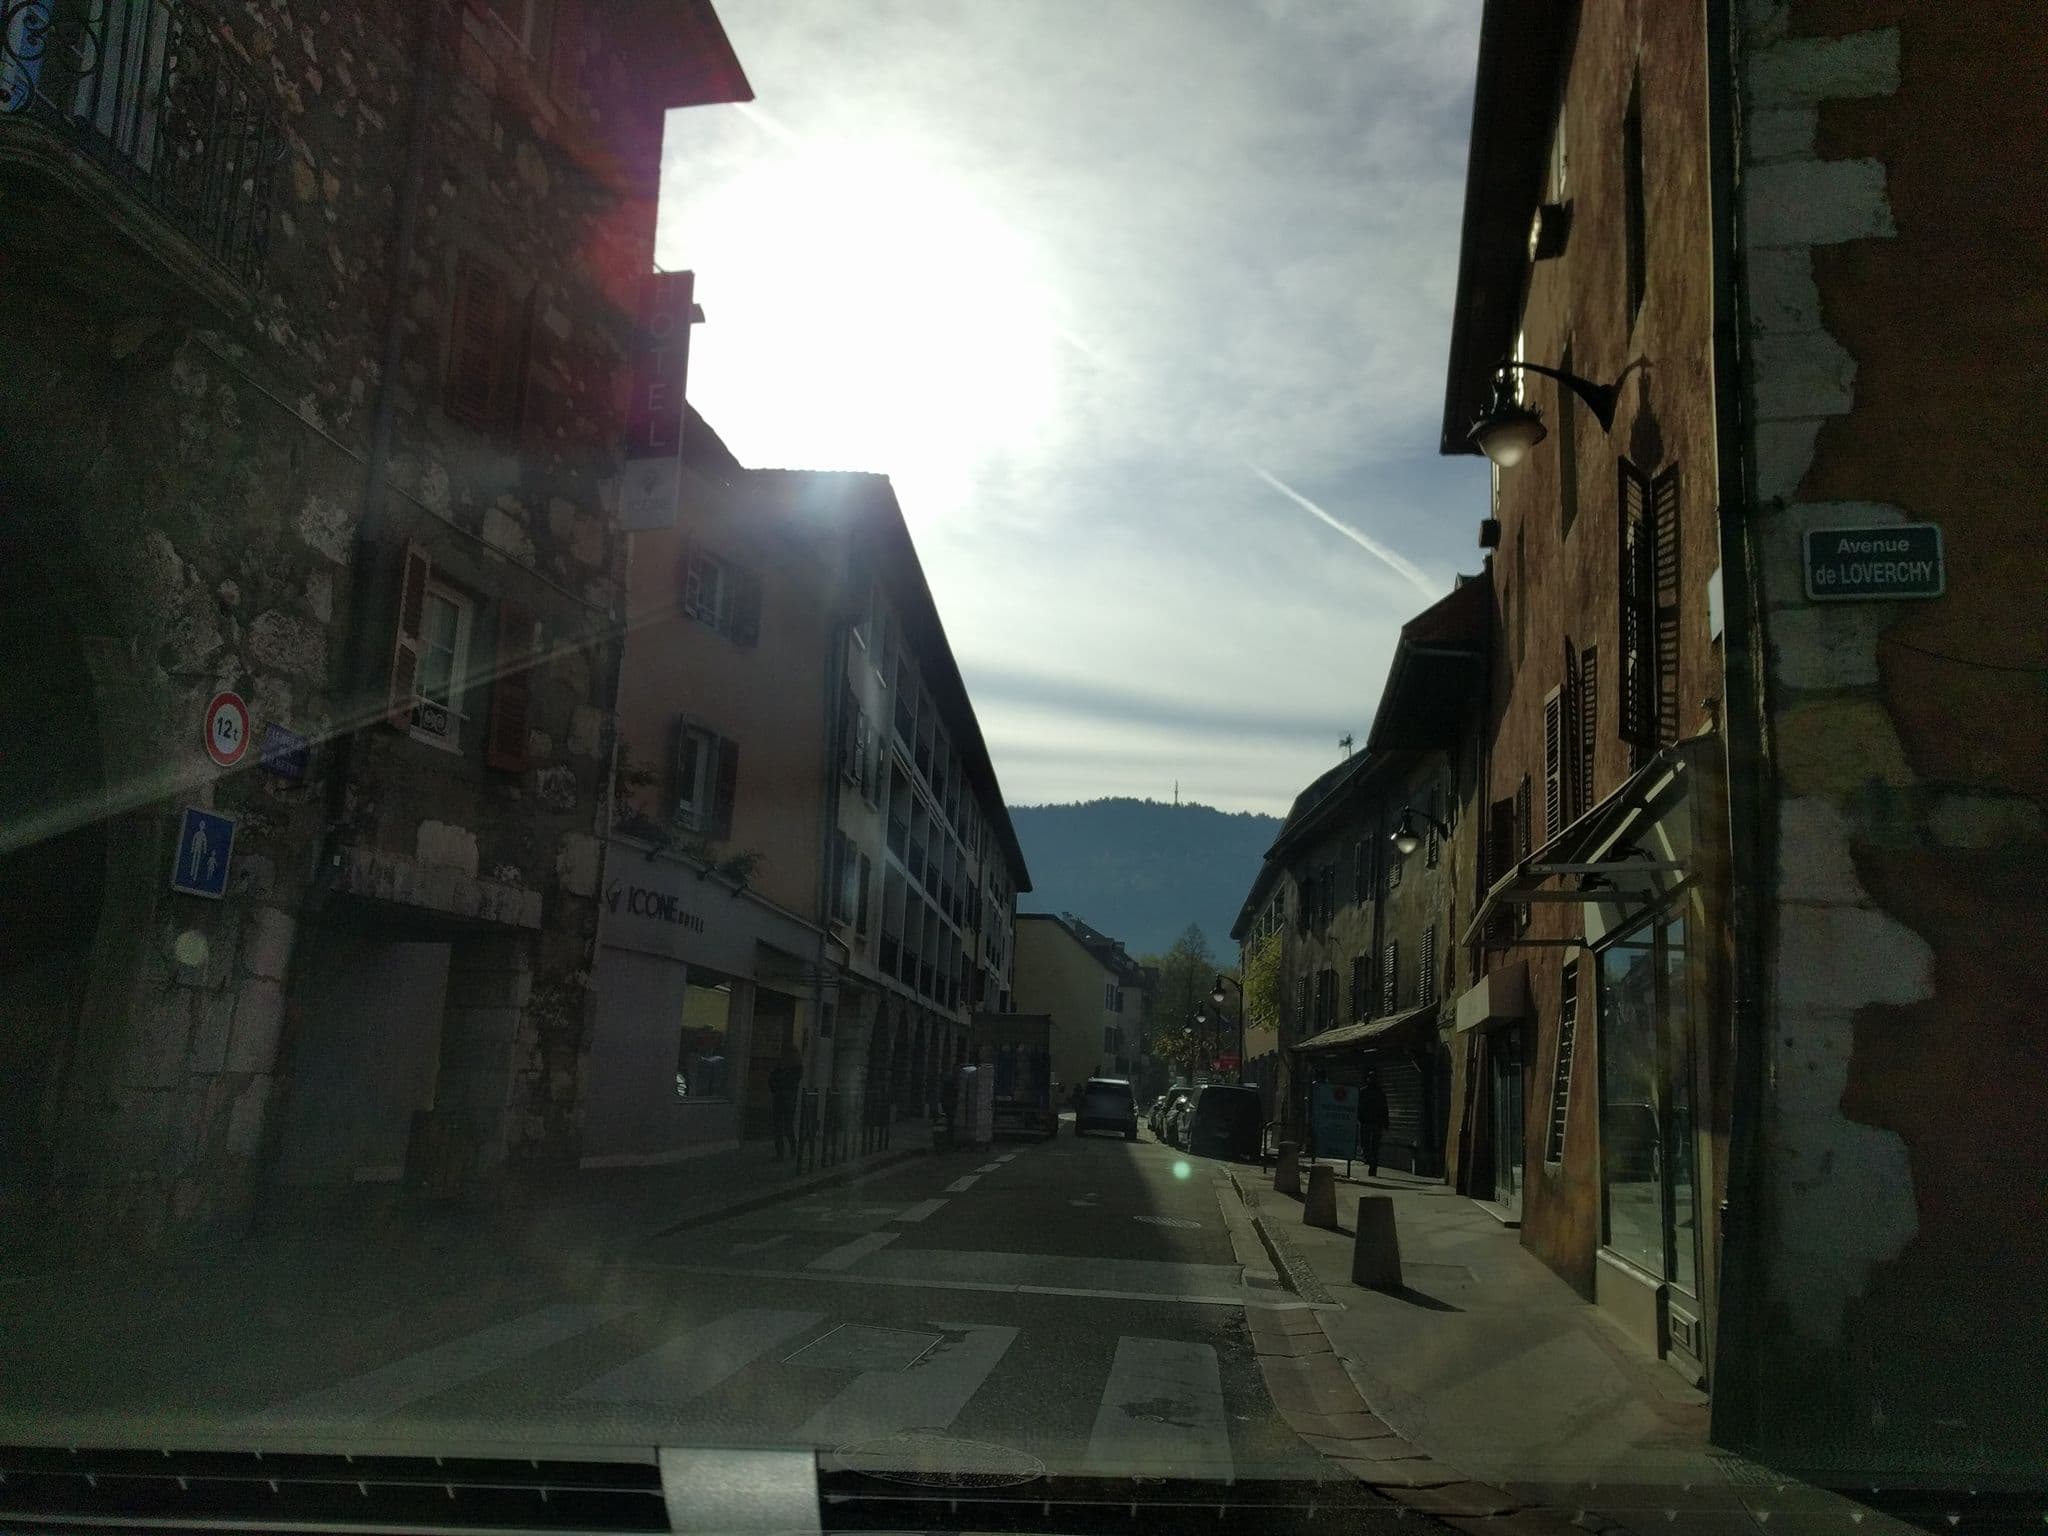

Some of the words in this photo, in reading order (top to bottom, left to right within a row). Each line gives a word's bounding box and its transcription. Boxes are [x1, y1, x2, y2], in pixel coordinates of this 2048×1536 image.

[648, 279, 674, 449] HOTEL
[1837, 538, 1910, 553] Avenue
[1816, 564, 1836, 584] de
[1840, 560, 1933, 583] LOVERCHY
[627, 885, 679, 923] ICONE
